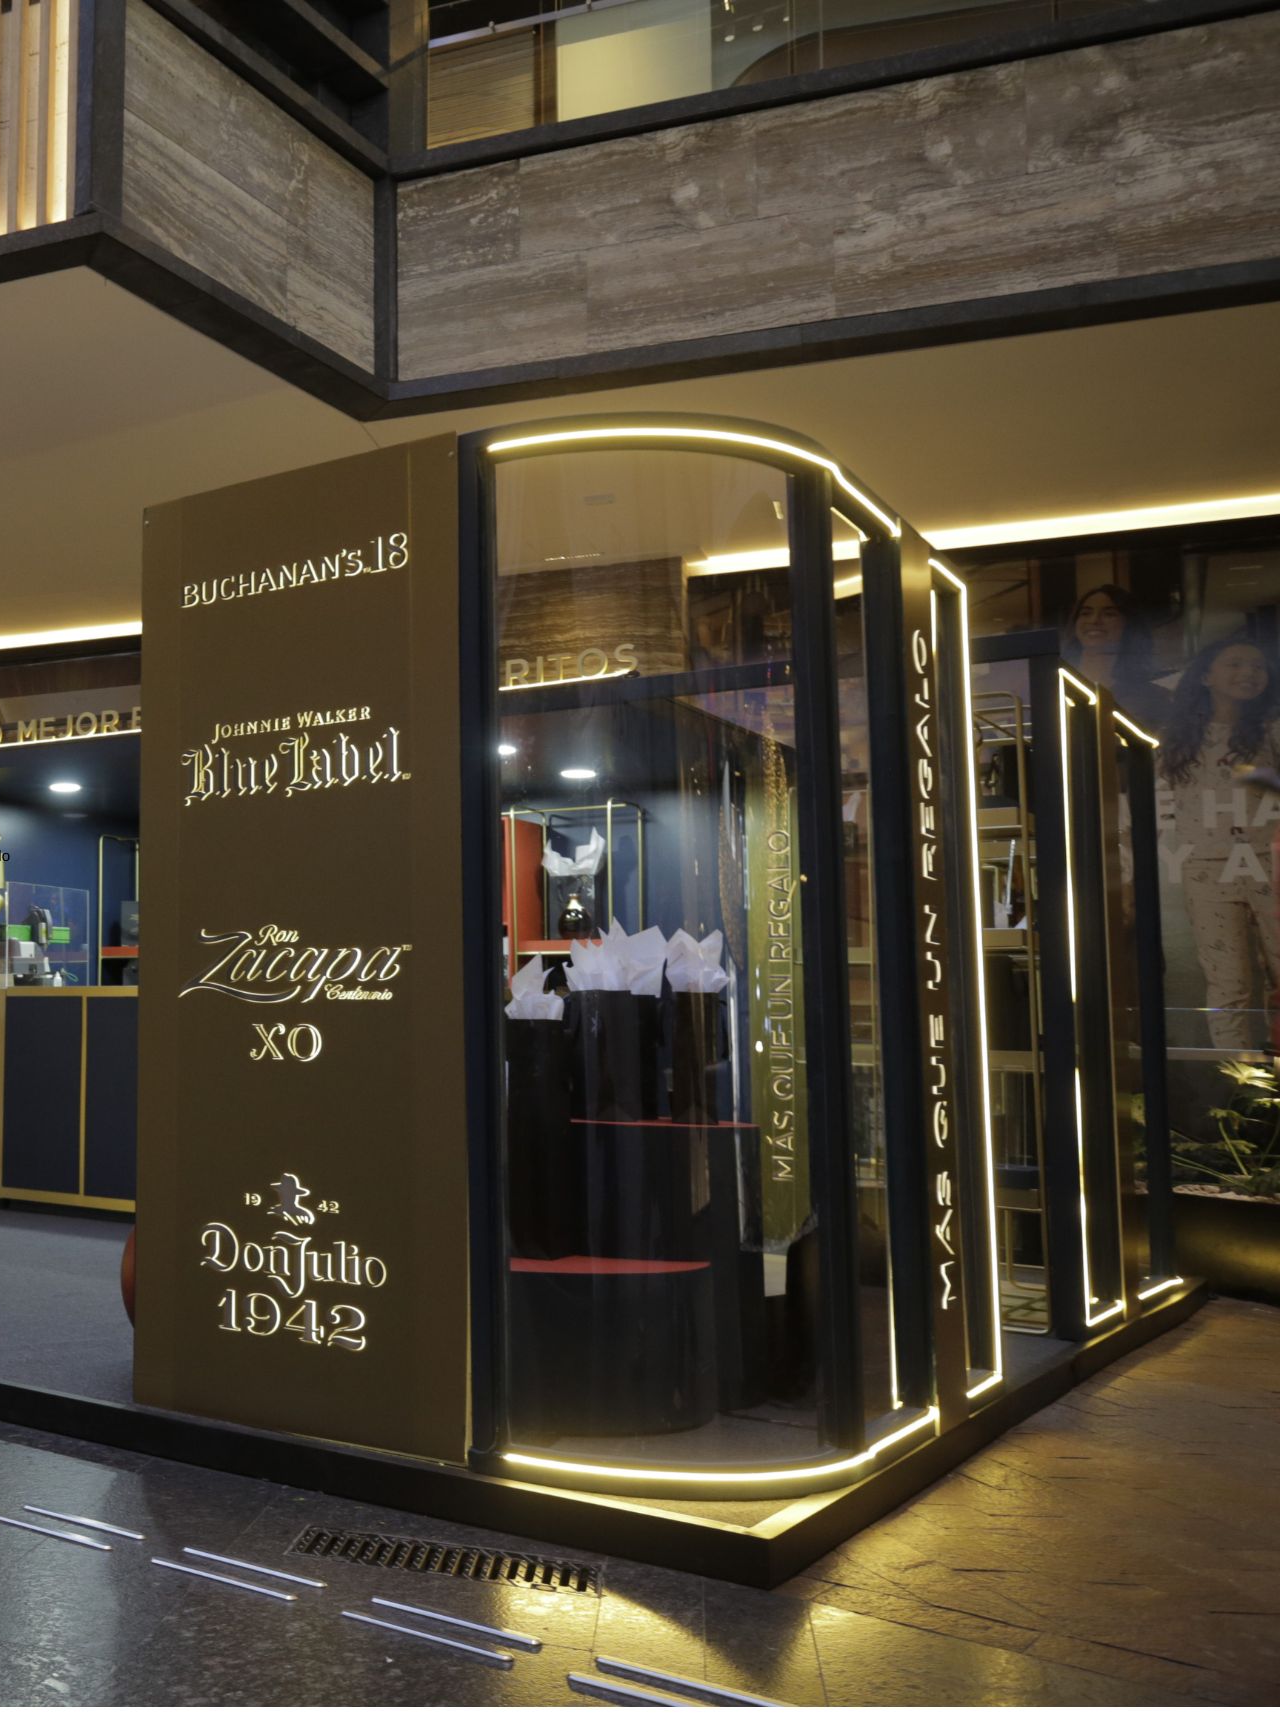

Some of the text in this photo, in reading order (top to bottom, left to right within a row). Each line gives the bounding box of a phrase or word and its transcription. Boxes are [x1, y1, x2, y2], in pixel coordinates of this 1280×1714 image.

[181, 532, 409, 608] BUCHANAN'S 18
[17, 708, 120, 744] MEJOR
[211, 706, 372, 744] JOHNNIE WALKER
[180, 727, 403, 807] Blue Label
[911, 629, 939, 882] REGALO
[767, 829, 793, 963] REGALO
[254, 924, 300, 946] Ron
[923, 904, 942, 991] UN
[178, 929, 402, 1004] Zacapa
[324, 983, 393, 1001] Centenario
[768, 975, 794, 1020] UN
[250, 1023, 323, 1062] XO
[244, 1192, 340, 1214] 19 42
[218, 1289, 367, 1352] 1942
